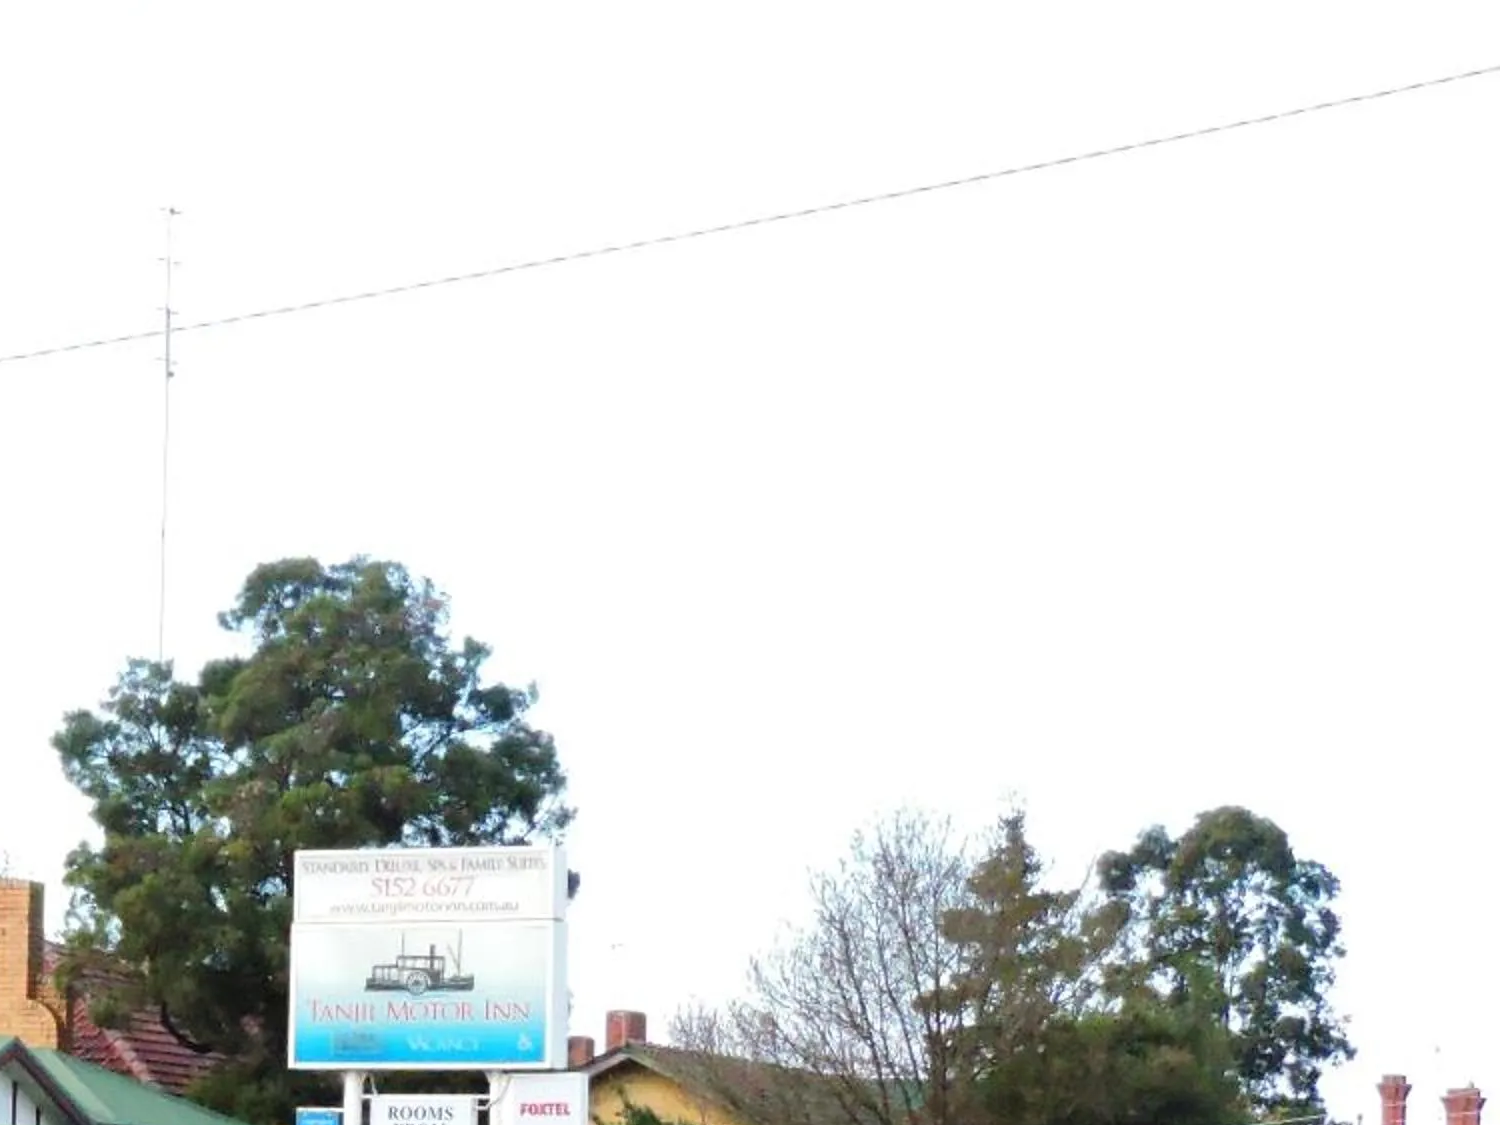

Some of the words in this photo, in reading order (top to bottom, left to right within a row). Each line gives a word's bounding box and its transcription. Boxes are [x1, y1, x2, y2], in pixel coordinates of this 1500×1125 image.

[371, 876, 415, 898] 5152
[422, 875, 476, 898] 6677
[387, 1000, 474, 1021] MOTOR
[484, 999, 531, 1020] INN
[388, 1105, 454, 1121] ROOMS
[520, 1102, 571, 1117] FOXTEL
